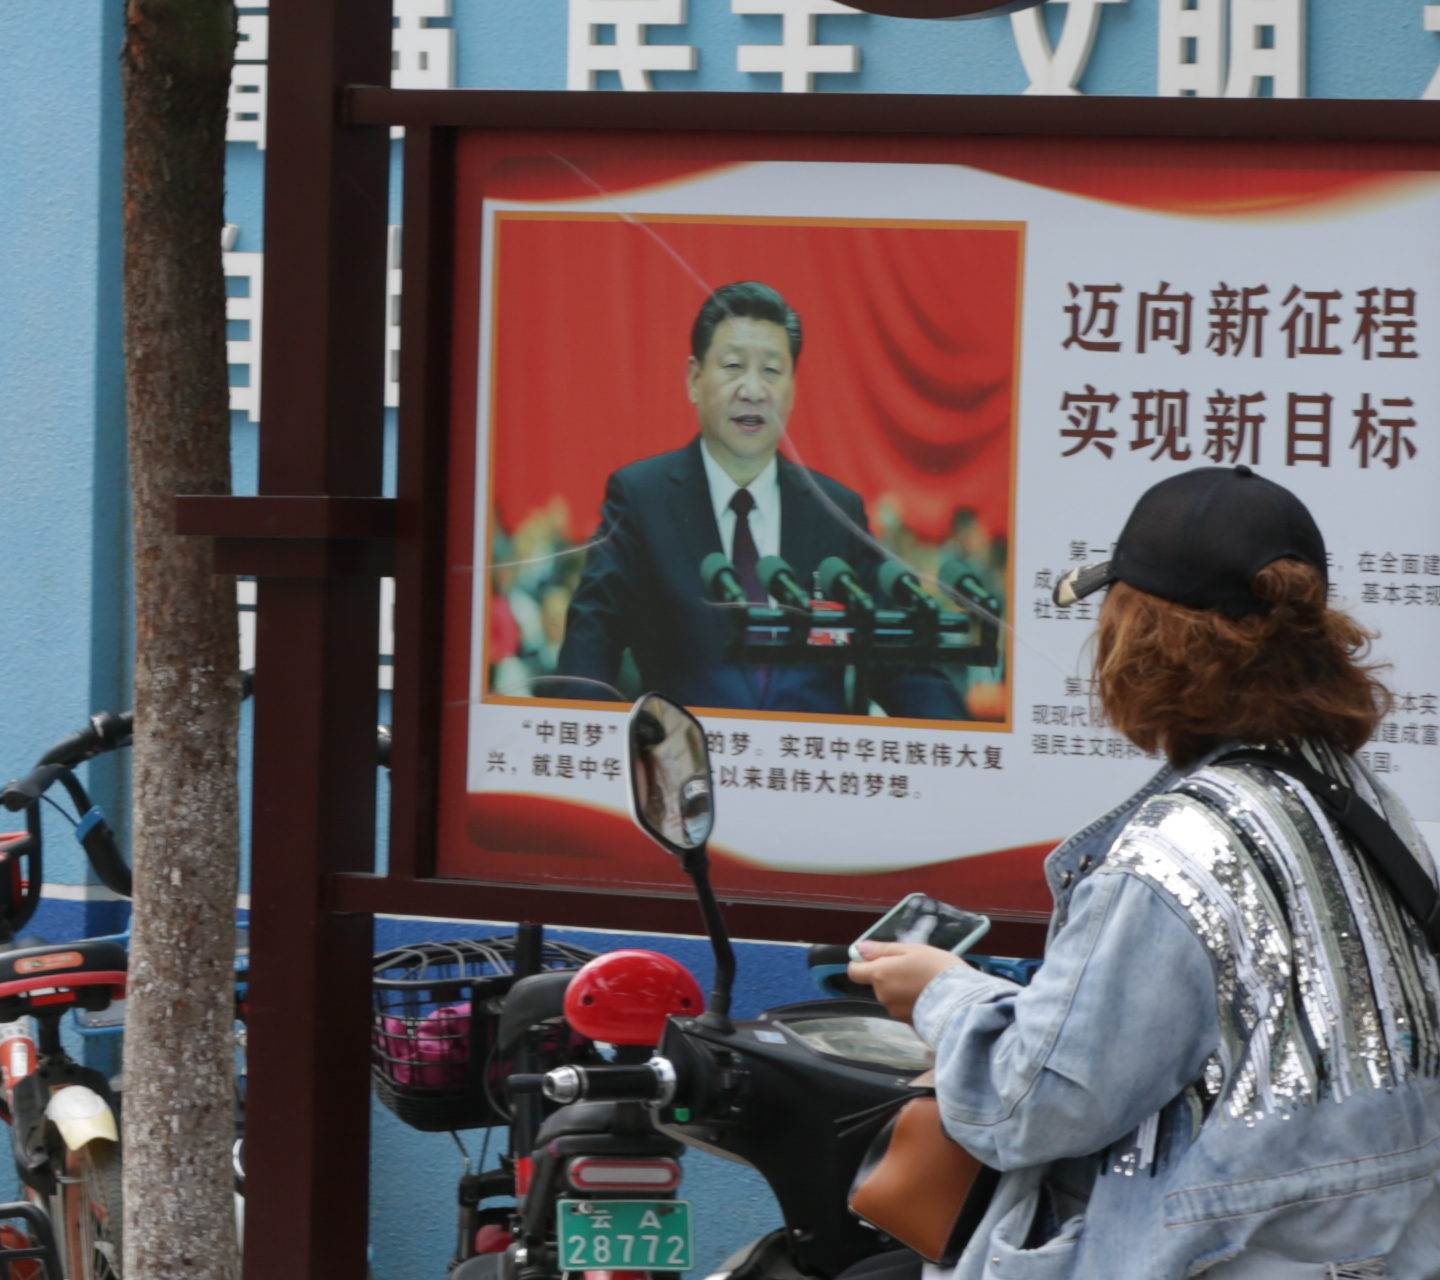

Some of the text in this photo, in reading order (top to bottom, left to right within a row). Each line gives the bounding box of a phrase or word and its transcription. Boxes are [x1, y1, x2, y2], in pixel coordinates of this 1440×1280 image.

[1060, 280, 1419, 362] 迈向新征程
[1057, 384, 1418, 470] 实现新目标
[1068, 540, 1118, 561] 第一
[521, 718, 1005, 772] “中国梦”的梦。实现中华民族伟大复
[1032, 733, 1167, 761] 强民主文明和
[486, 749, 922, 800] 兴，就是中华以来最伟大的梦想。
[589, 1209, 663, 1229] 云 A
[568, 1234, 686, 1265] 28772
